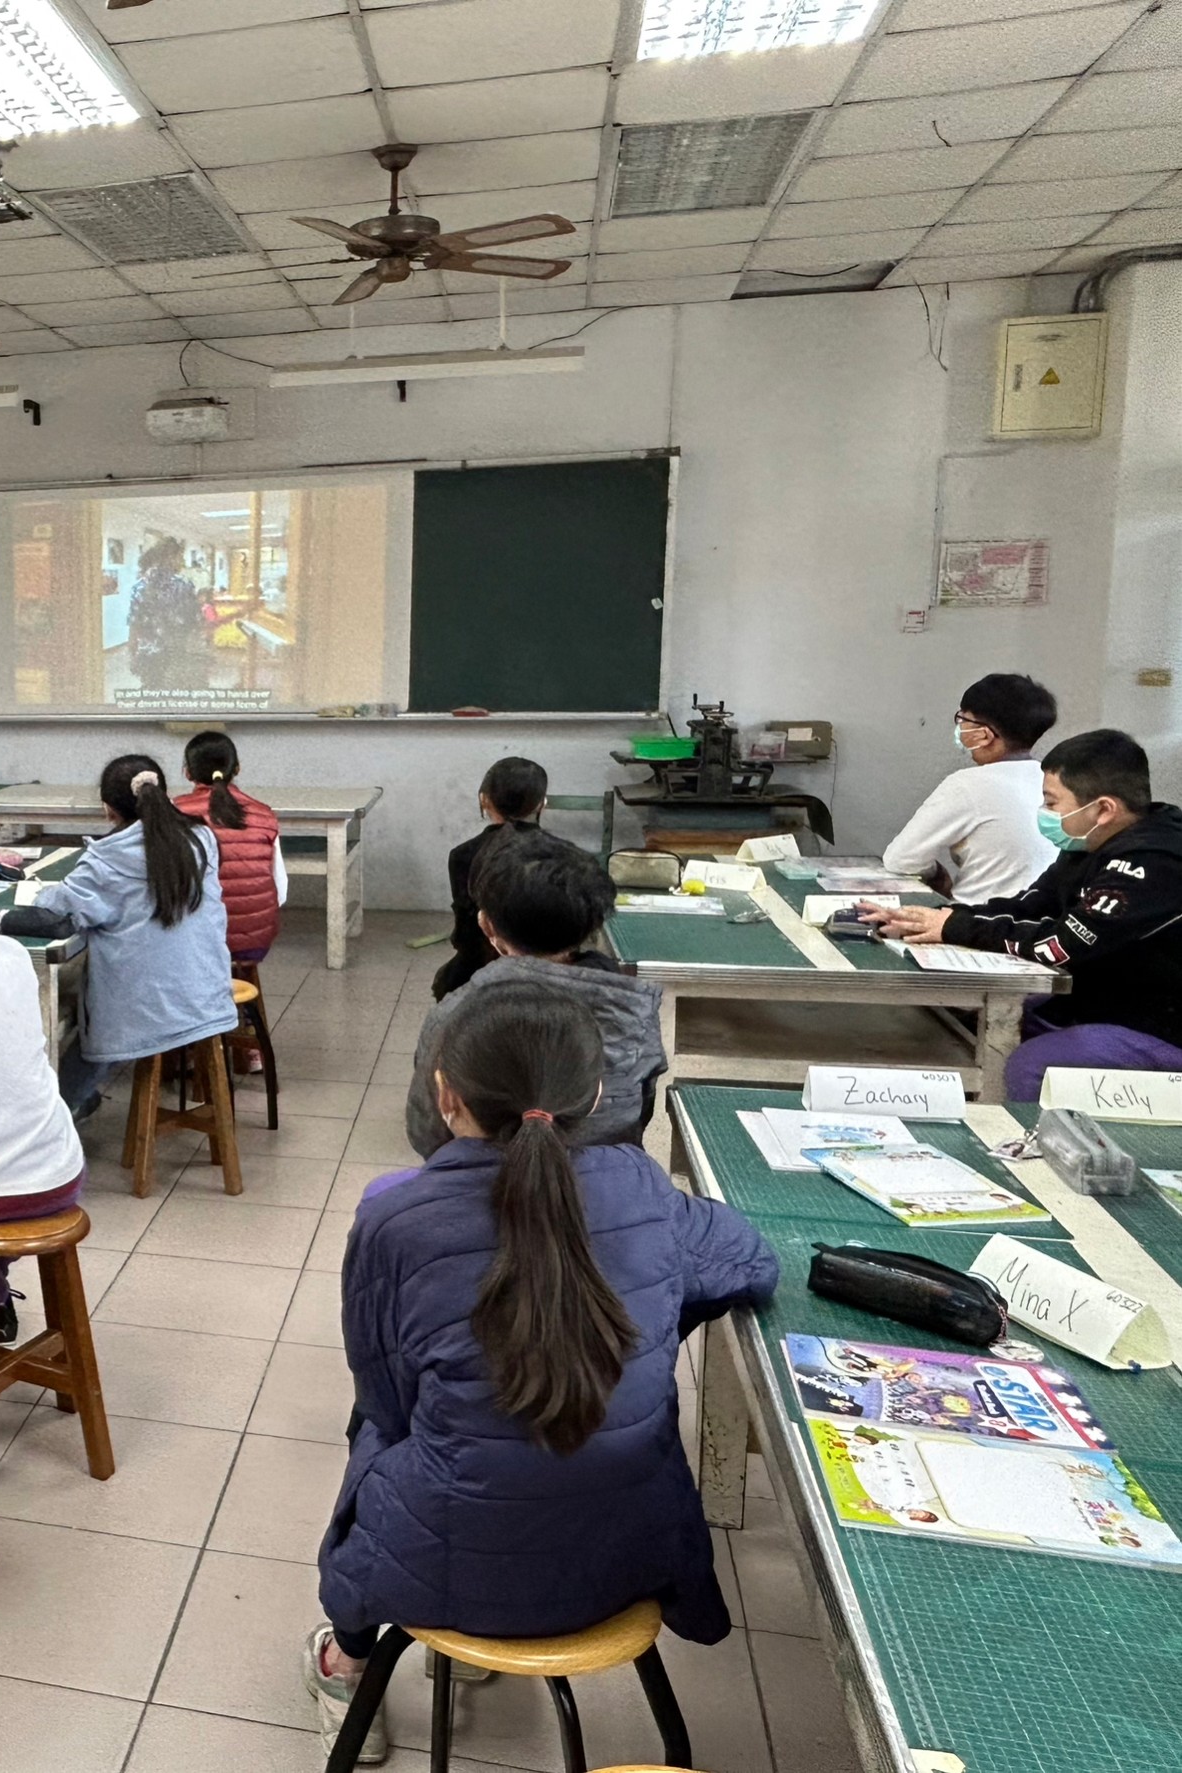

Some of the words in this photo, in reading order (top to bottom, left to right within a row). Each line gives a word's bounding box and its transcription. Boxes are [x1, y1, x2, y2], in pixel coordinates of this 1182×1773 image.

[1106, 859, 1146, 880] FILA
[1091, 895, 1119, 915] 11
[837, 1075, 929, 1113] Zachary
[1090, 1075, 1153, 1116] Kelly
[996, 1256, 1051, 1321] Mina
